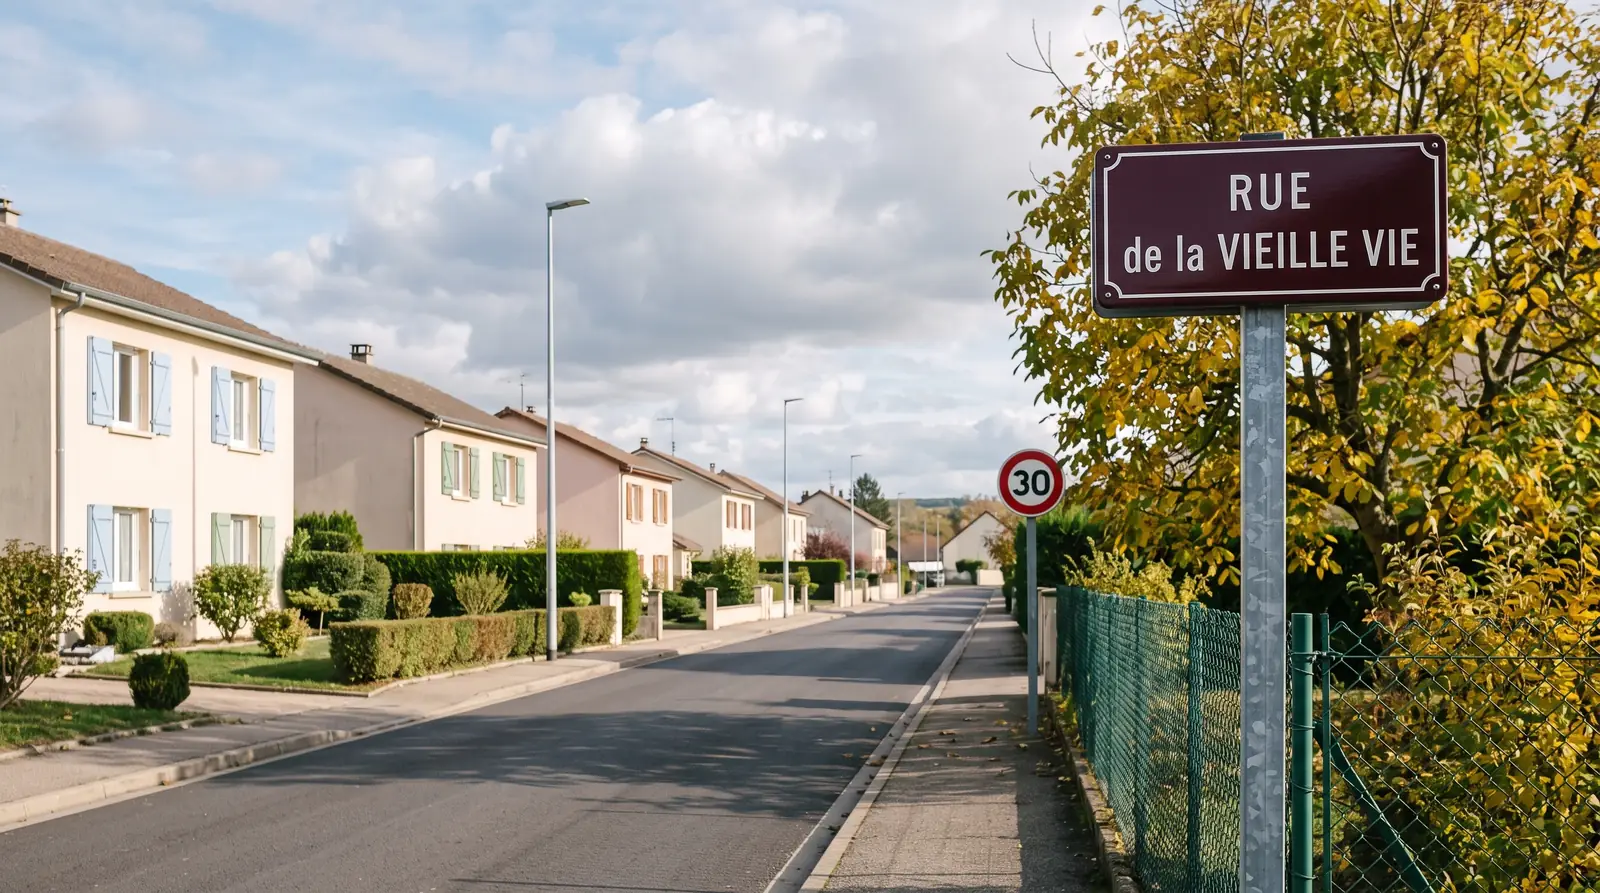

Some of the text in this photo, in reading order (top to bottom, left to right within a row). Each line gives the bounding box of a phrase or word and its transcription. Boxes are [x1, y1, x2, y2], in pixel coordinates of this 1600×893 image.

[1230, 171, 1311, 212] RUE
[1123, 228, 1419, 274] de la VIEILLE VIE
[1012, 469, 1051, 497] 30
